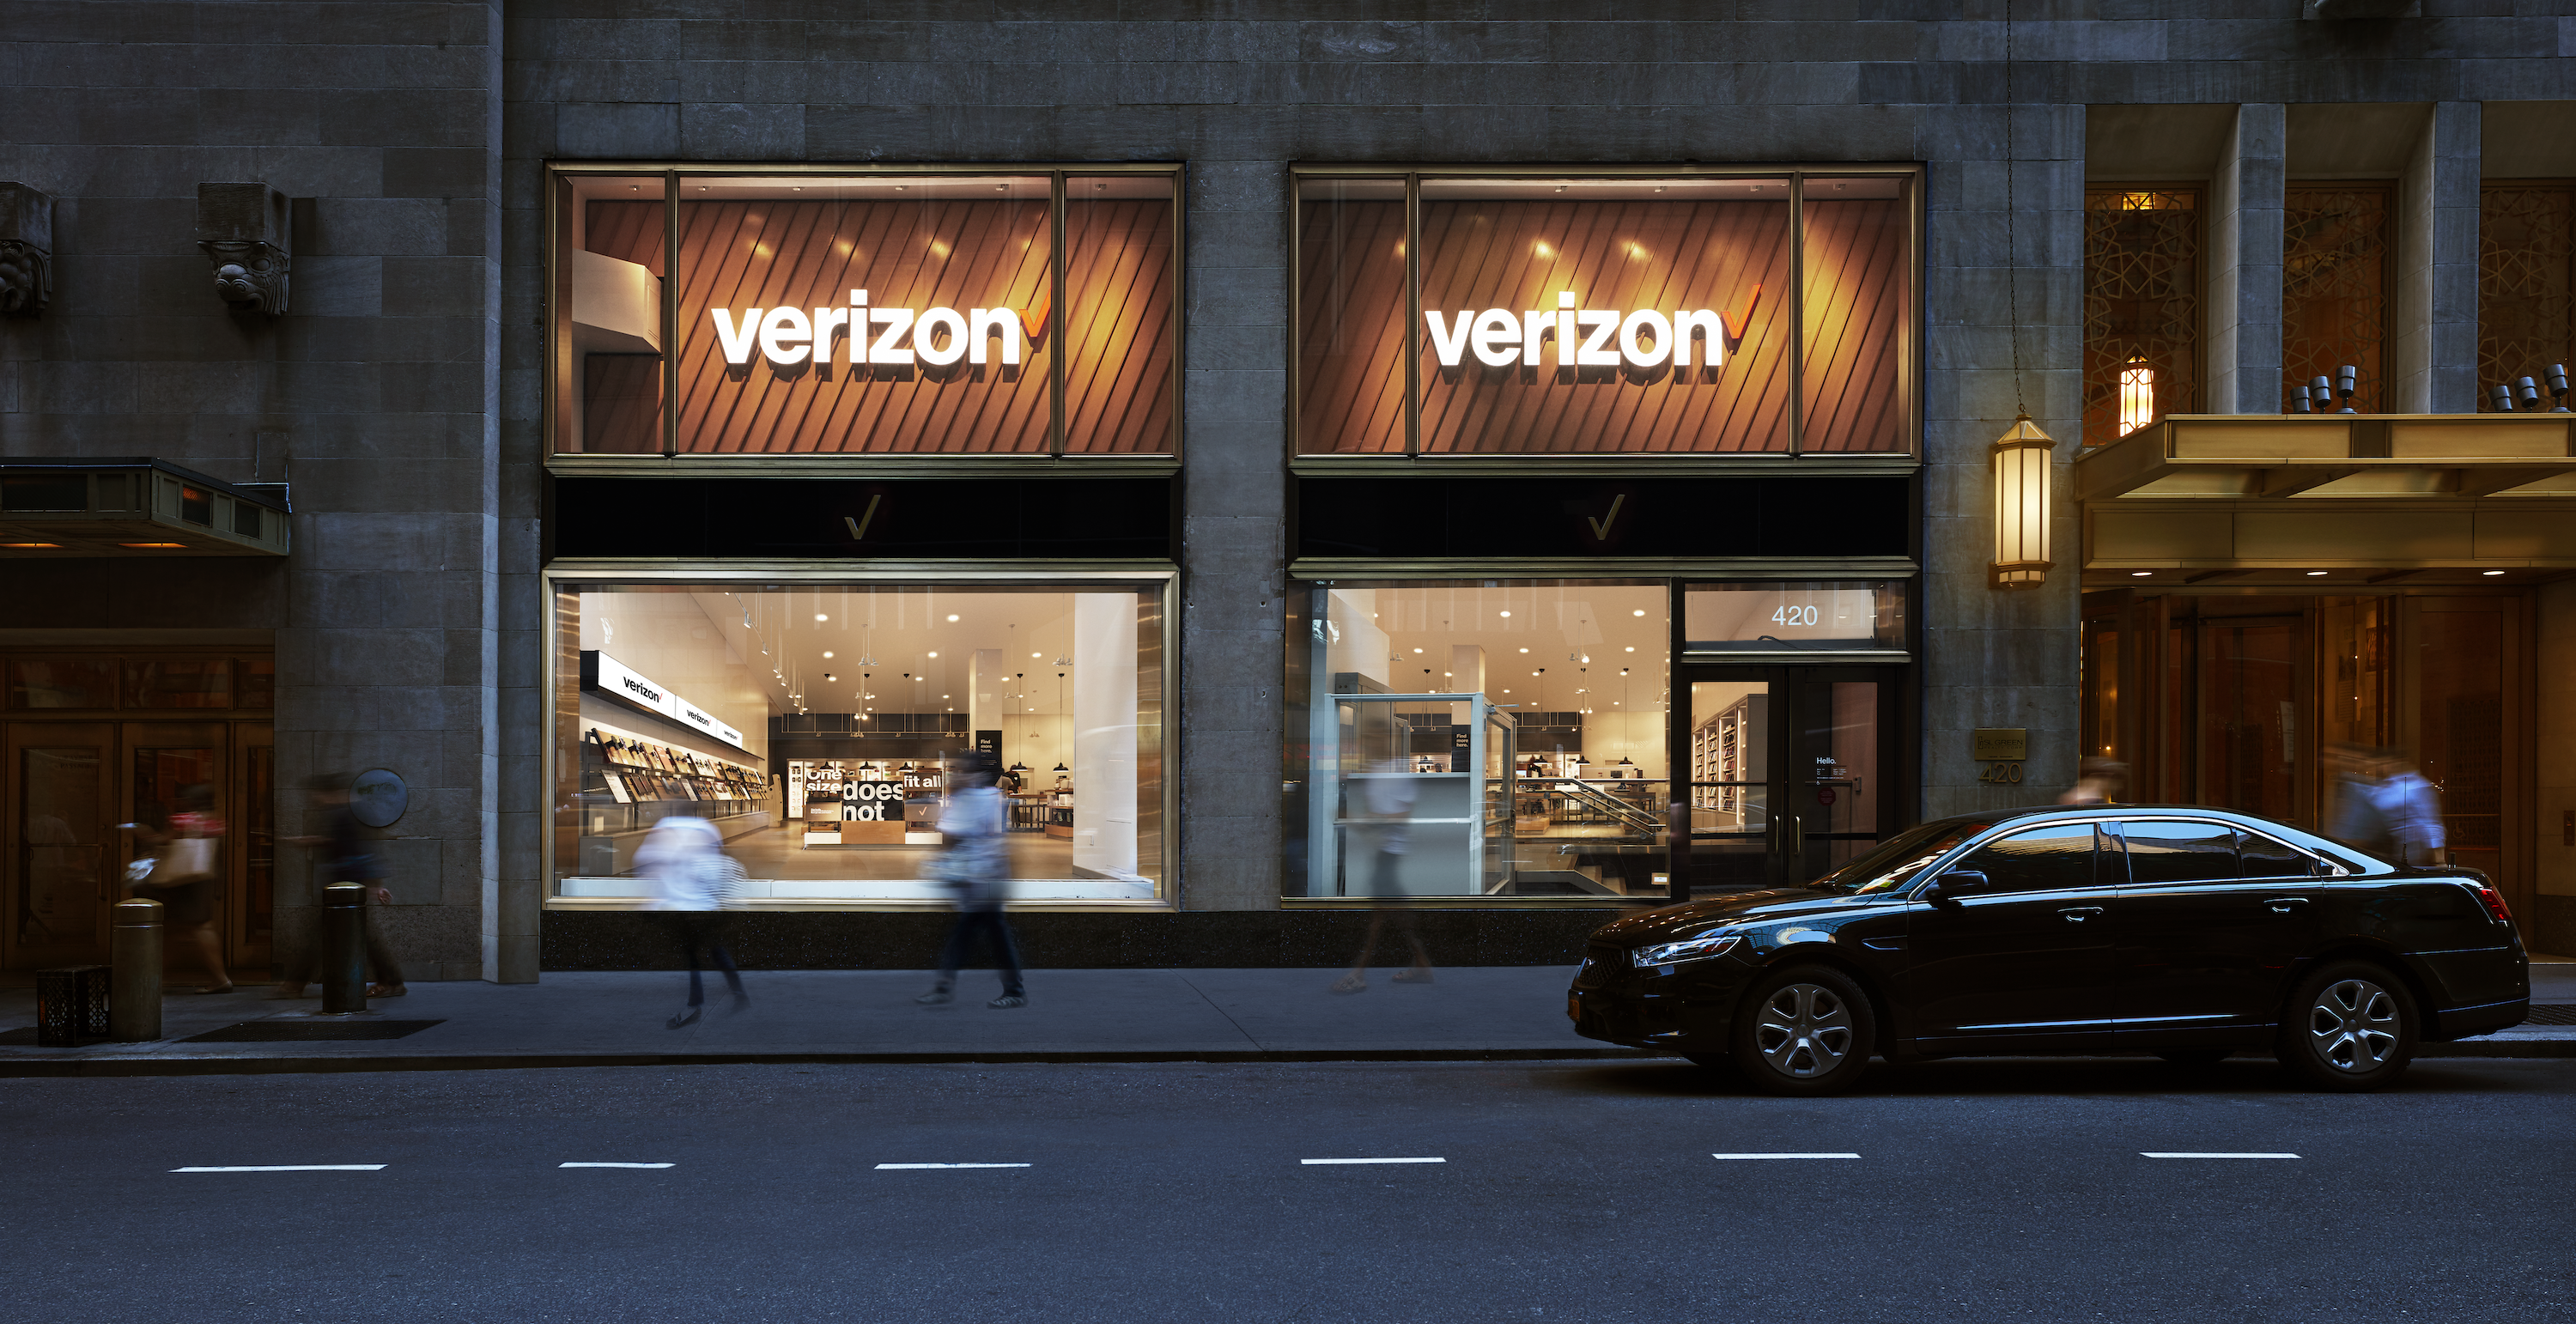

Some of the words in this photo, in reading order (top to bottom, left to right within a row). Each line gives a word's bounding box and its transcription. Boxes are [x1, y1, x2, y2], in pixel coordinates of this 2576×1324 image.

[711, 288, 1021, 365] verizon
[1425, 291, 1722, 367] verizon
[1771, 605, 1819, 627] 420
[623, 676, 659, 703] verizon
[687, 708, 709, 726] verizon
[724, 729, 738, 740] verizon
[806, 771, 842, 780] One
[904, 774, 920, 788] fit
[922, 775, 941, 788] all
[1978, 762, 2023, 783] 420
[806, 780, 841, 792] size
[843, 780, 904, 801] does
[843, 801, 885, 821] not
